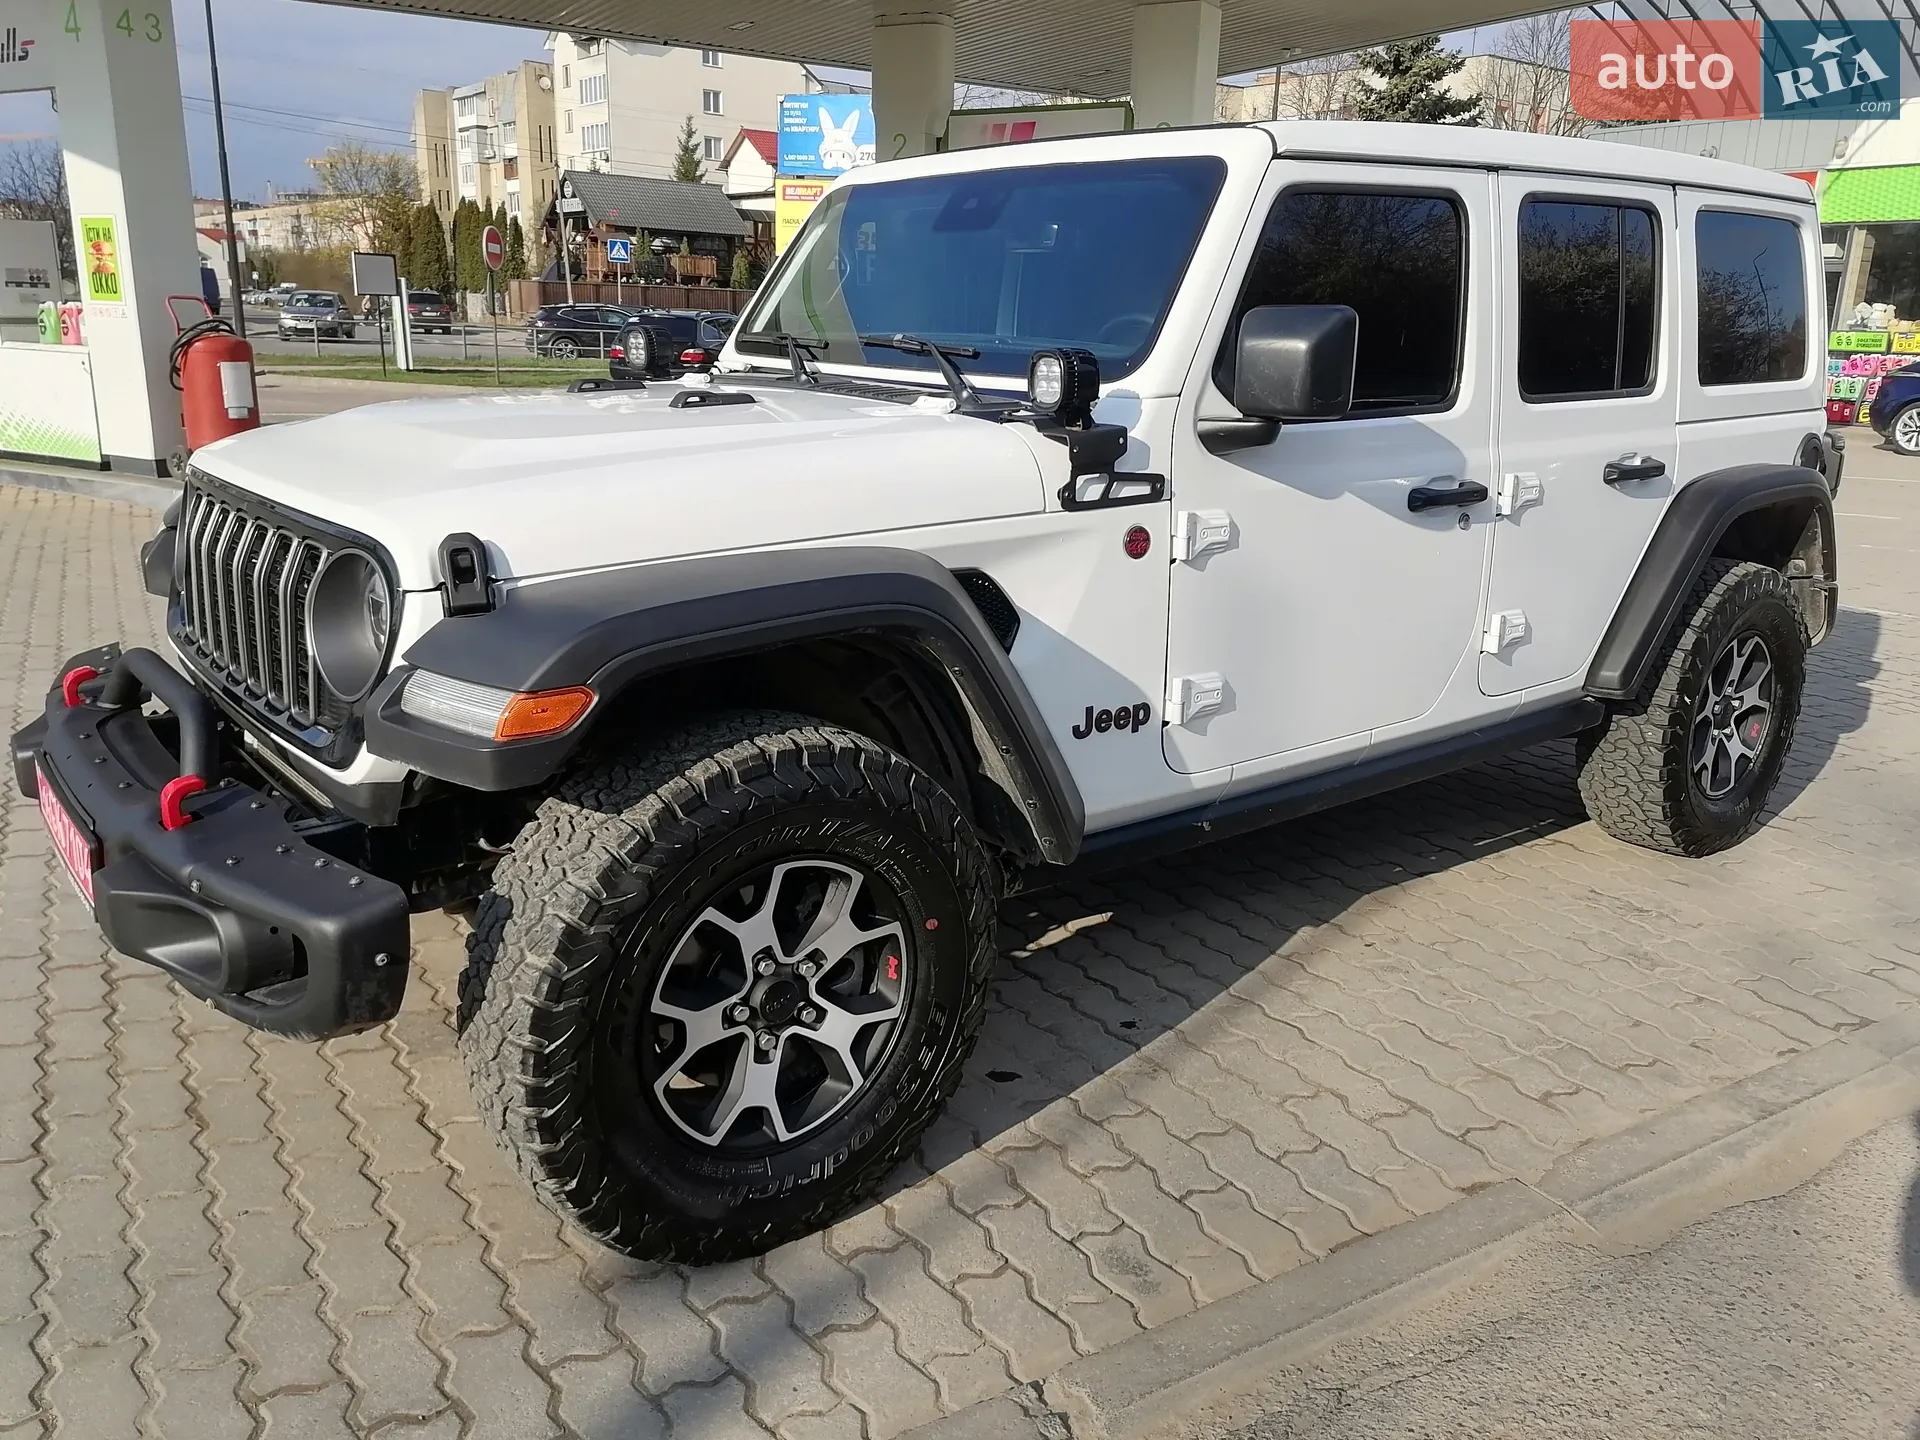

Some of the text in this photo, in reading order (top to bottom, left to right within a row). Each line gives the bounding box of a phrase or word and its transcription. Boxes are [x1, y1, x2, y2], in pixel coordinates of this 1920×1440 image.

[64, 0, 82, 43] 4
[116, 8, 163, 42] 4 3
[785, 187, 822, 195] ВЕЛМАРТ
[102, 227, 113, 242] НА
[91, 271, 118, 294] ОККО
[1072, 702, 1151, 740] Jeep
